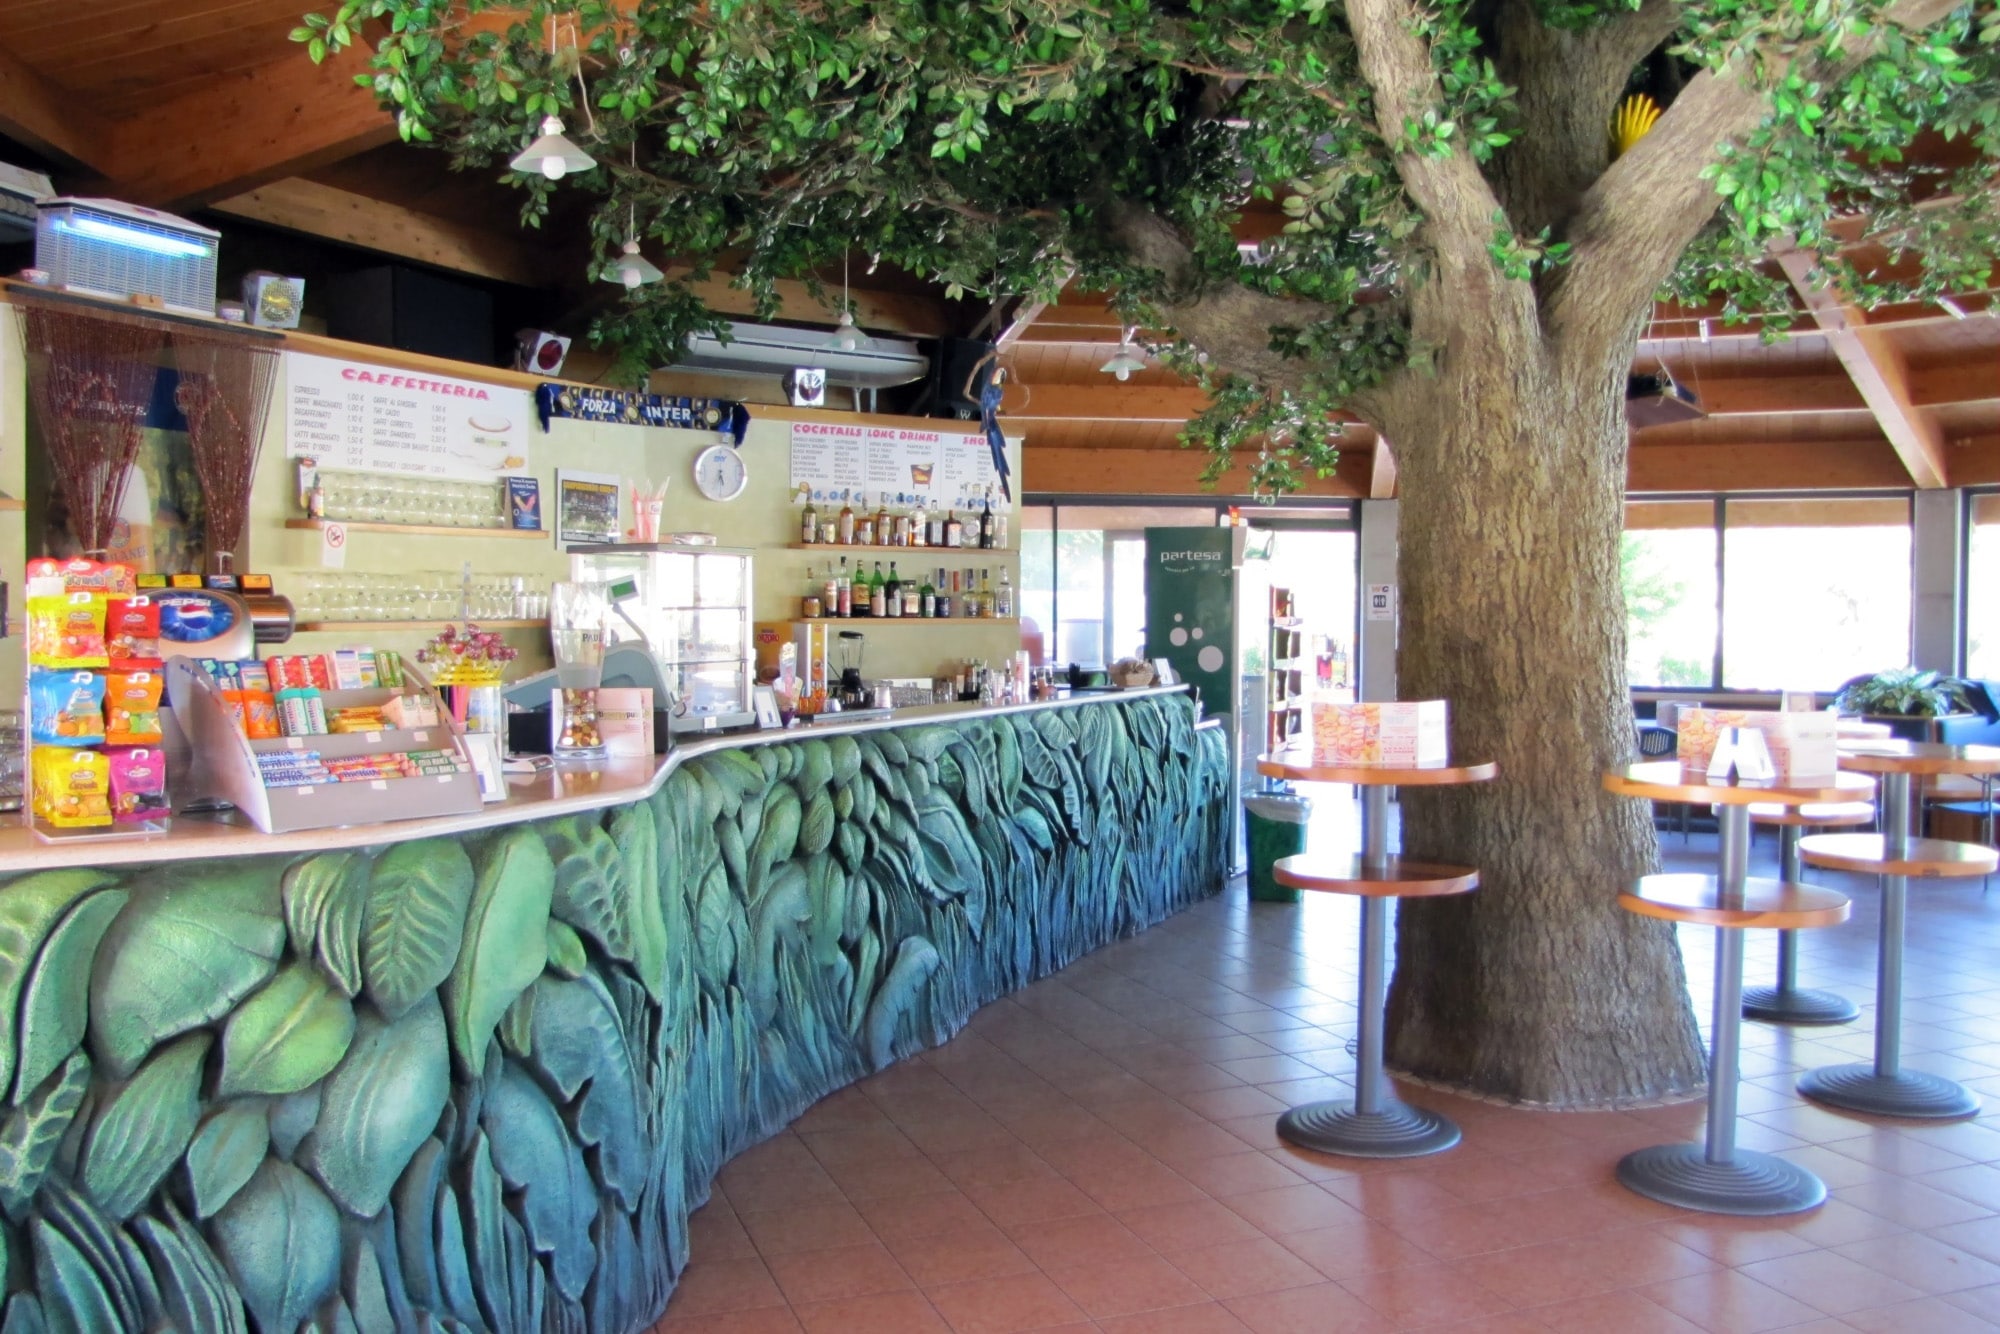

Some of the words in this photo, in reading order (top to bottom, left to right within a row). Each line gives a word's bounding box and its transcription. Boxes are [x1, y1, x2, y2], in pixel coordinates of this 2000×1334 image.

[342, 368, 490, 400] CAFFETTERIA
[582, 398, 616, 414] FORZA
[646, 406, 692, 420] INTER
[793, 424, 862, 437] COCKTAILS
[867, 429, 895, 439] LONG
[899, 431, 939, 442] DRINKS
[963, 436, 986, 446] SHO
[1160, 550, 1222, 563] partesa
[159, 598, 212, 607] PEPSI
[286, 701, 296, 732] mentos
[307, 700, 317, 731] mentos
[262, 770, 303, 778] mentos
